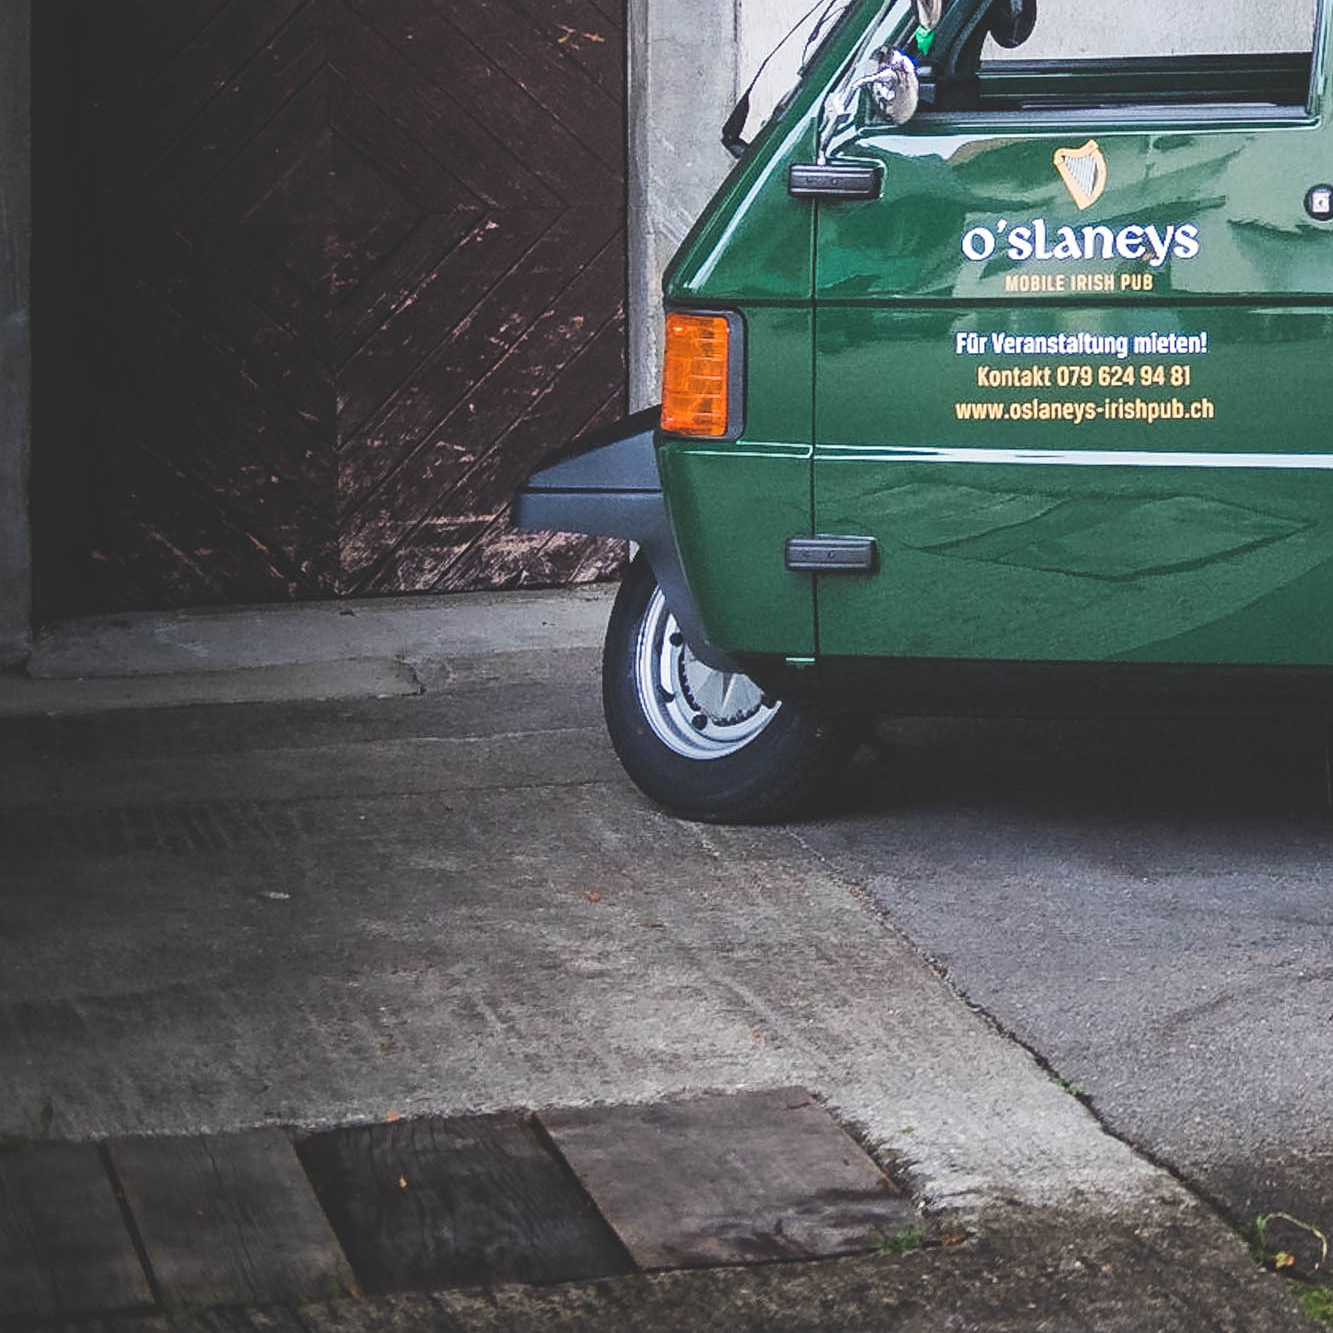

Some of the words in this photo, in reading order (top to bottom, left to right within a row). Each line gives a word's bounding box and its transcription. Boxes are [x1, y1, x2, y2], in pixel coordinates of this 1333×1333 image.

[961, 217, 1200, 267] o'slaneys
[1005, 274, 1065, 292] MOBILE
[1070, 274, 1115, 292] IRISH
[1121, 274, 1154, 291] PUB
[955, 331, 988, 355] Für
[991, 331, 1128, 358] Veranstaltung
[1133, 331, 1208, 354] mieten!
[977, 366, 1052, 387] Kontakt
[1056, 366, 1093, 387] 079
[1098, 366, 1135, 387] 624
[1140, 366, 1166, 387] 94
[1170, 365, 1191, 387] 81
[955, 398, 1215, 424] www.oslaneys-irishpub.ch
